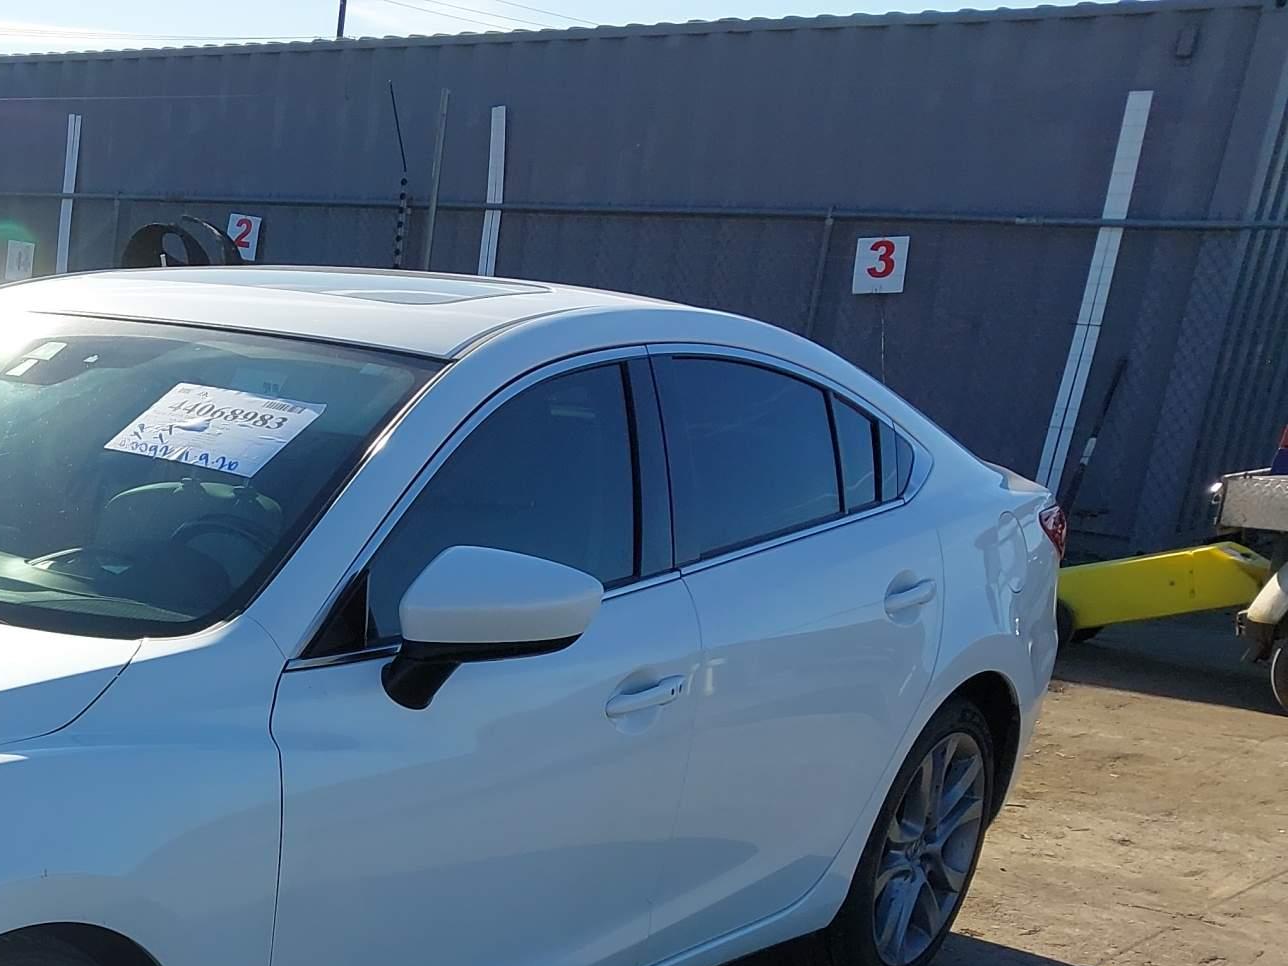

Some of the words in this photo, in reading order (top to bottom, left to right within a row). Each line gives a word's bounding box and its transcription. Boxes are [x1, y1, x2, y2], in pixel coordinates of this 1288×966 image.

[235, 218, 253, 248] 2
[867, 240, 895, 278] 3
[168, 400, 288, 430] 44068983
